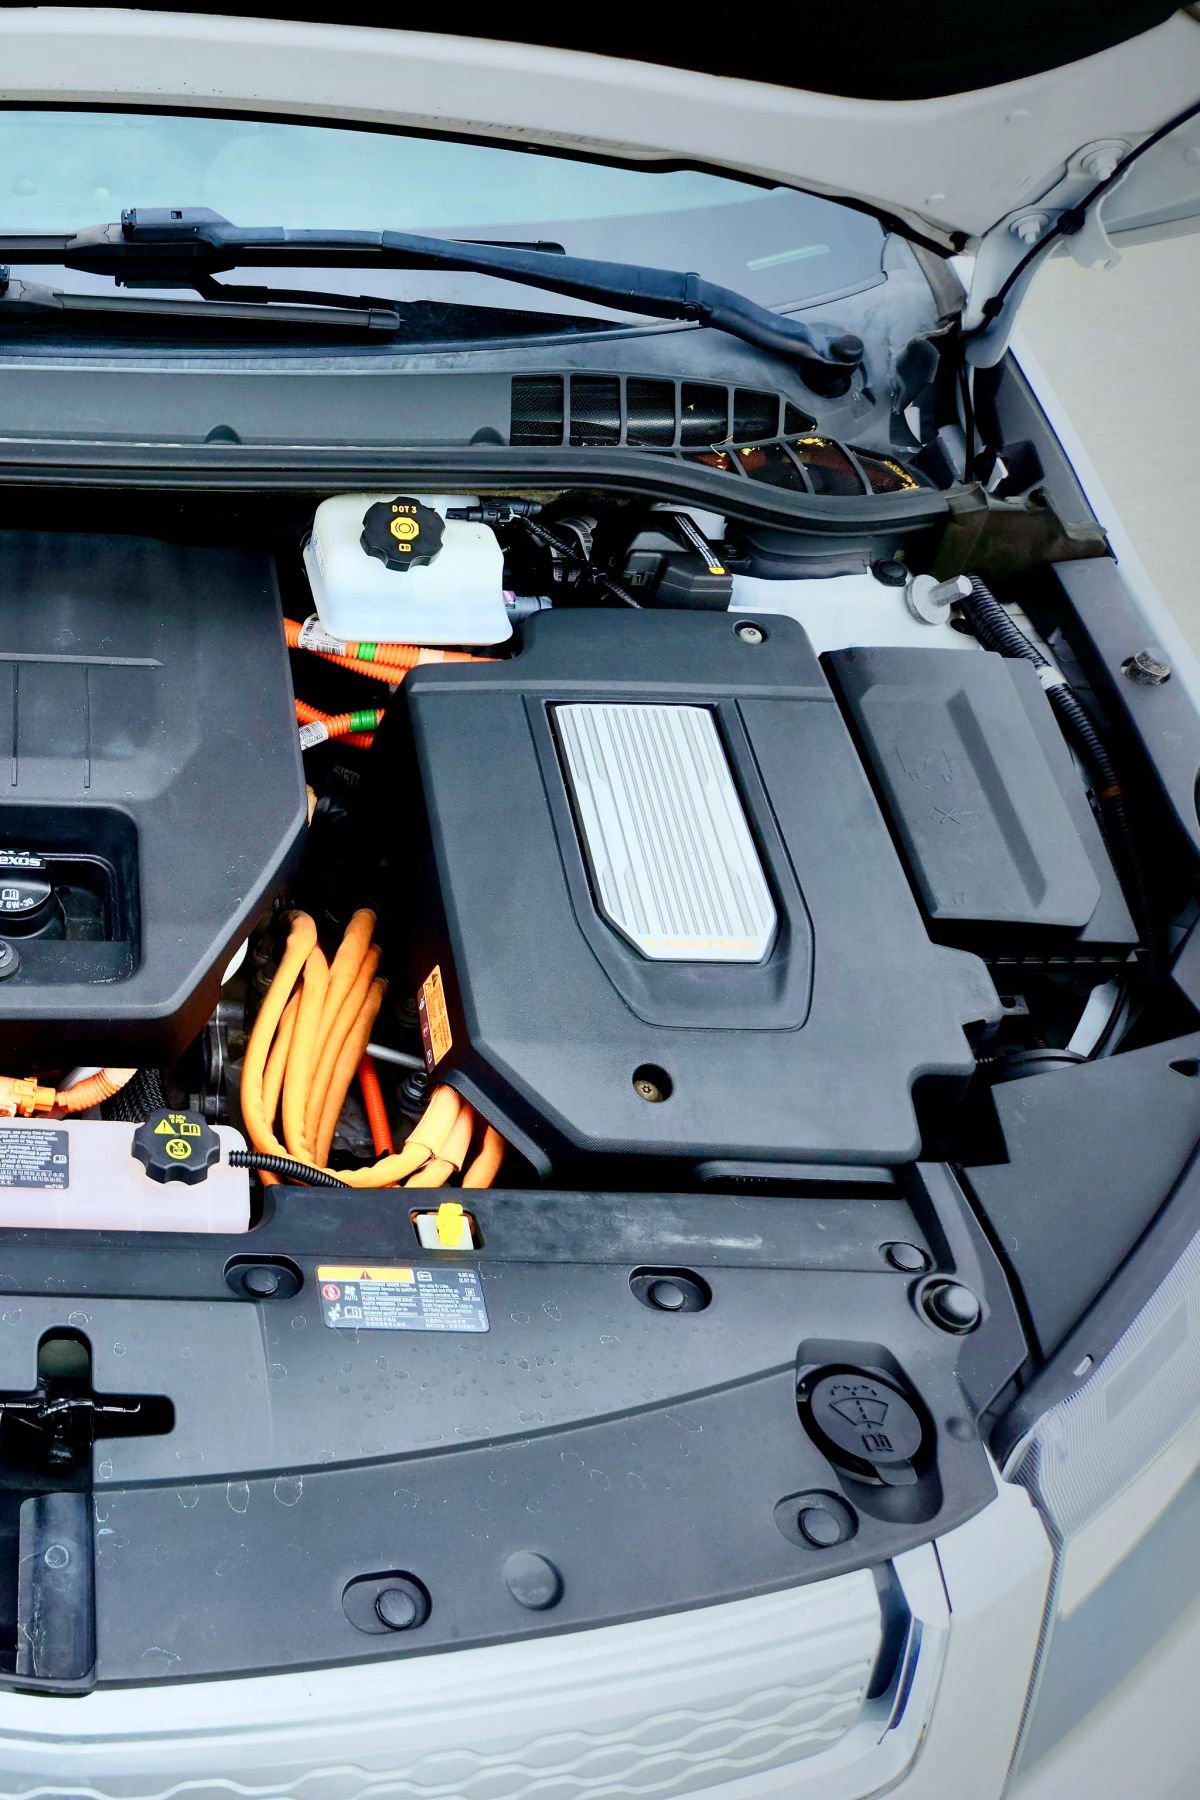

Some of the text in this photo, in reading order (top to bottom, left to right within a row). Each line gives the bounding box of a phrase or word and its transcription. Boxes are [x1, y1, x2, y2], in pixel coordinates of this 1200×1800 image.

[392, 505, 418, 514] DOT 3
[6, 898, 34, 908] 5W-30
